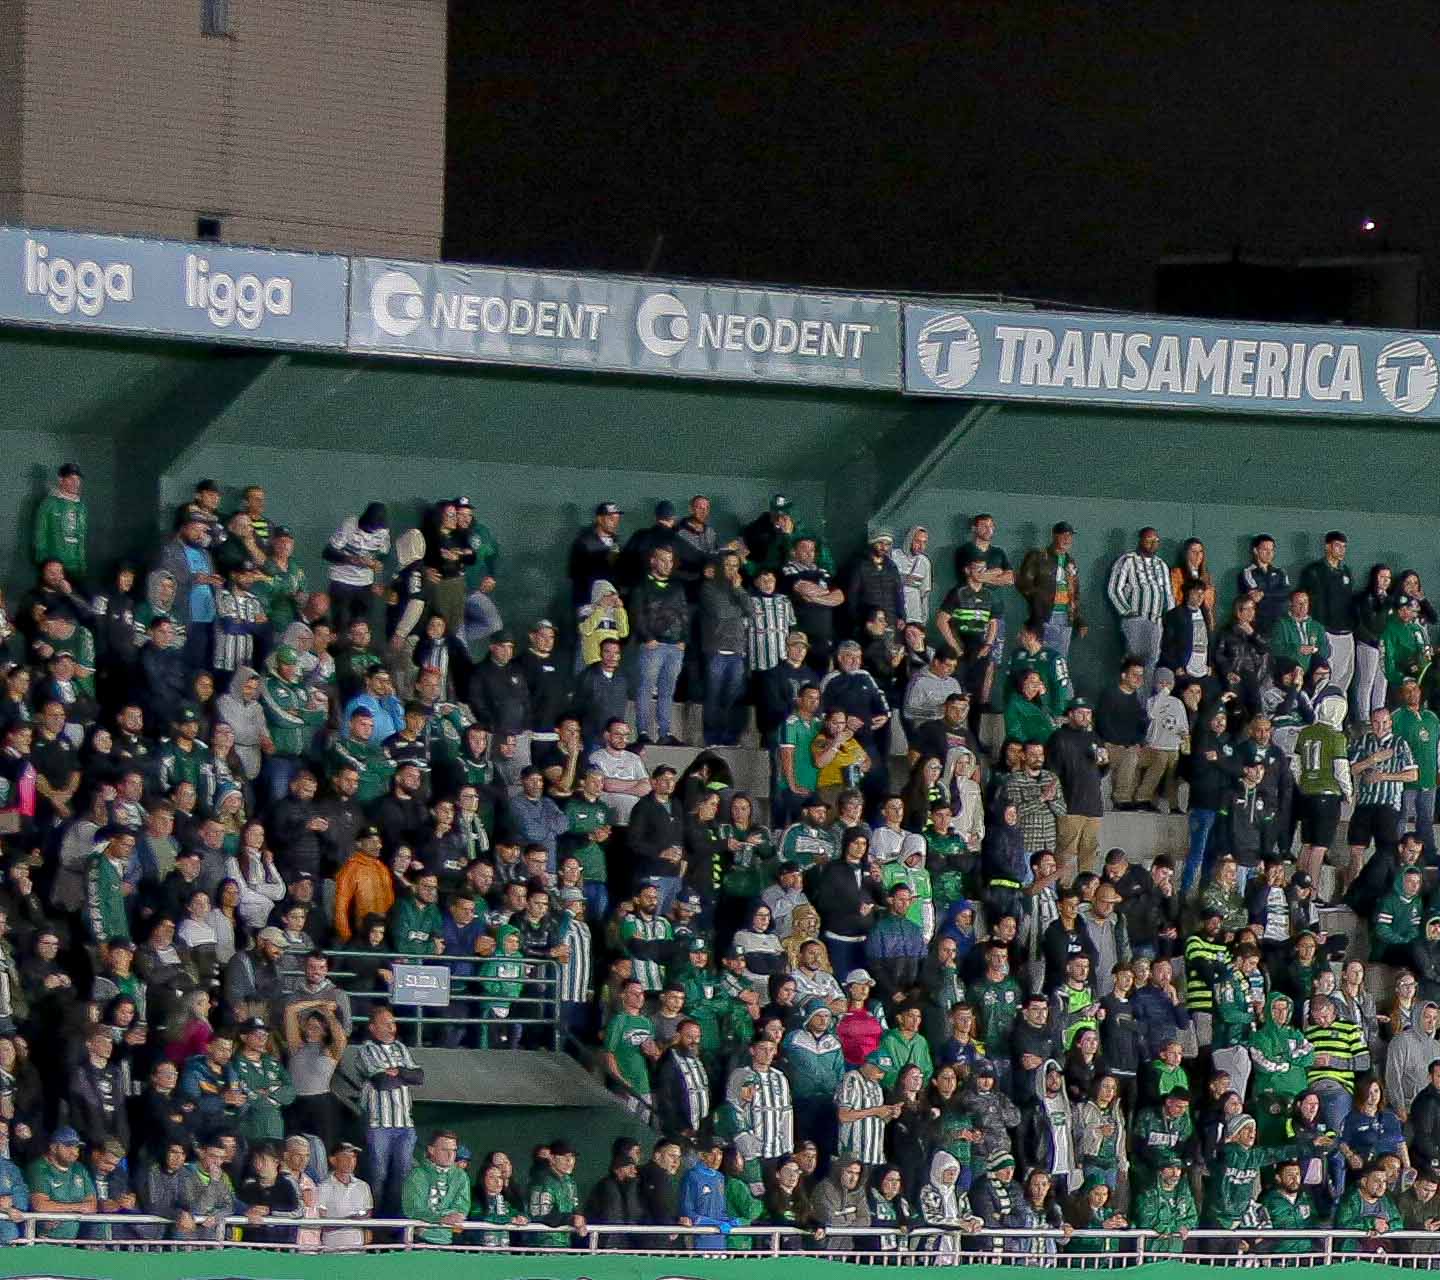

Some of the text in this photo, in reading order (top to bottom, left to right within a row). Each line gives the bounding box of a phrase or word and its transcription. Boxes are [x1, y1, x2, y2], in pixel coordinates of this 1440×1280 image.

[25, 240, 133, 318] ligga
[184, 254, 293, 331] ligga
[431, 291, 607, 342] NEODENT
[698, 310, 872, 361] NEODENT
[993, 325, 1365, 404] TRANSAMERICA
